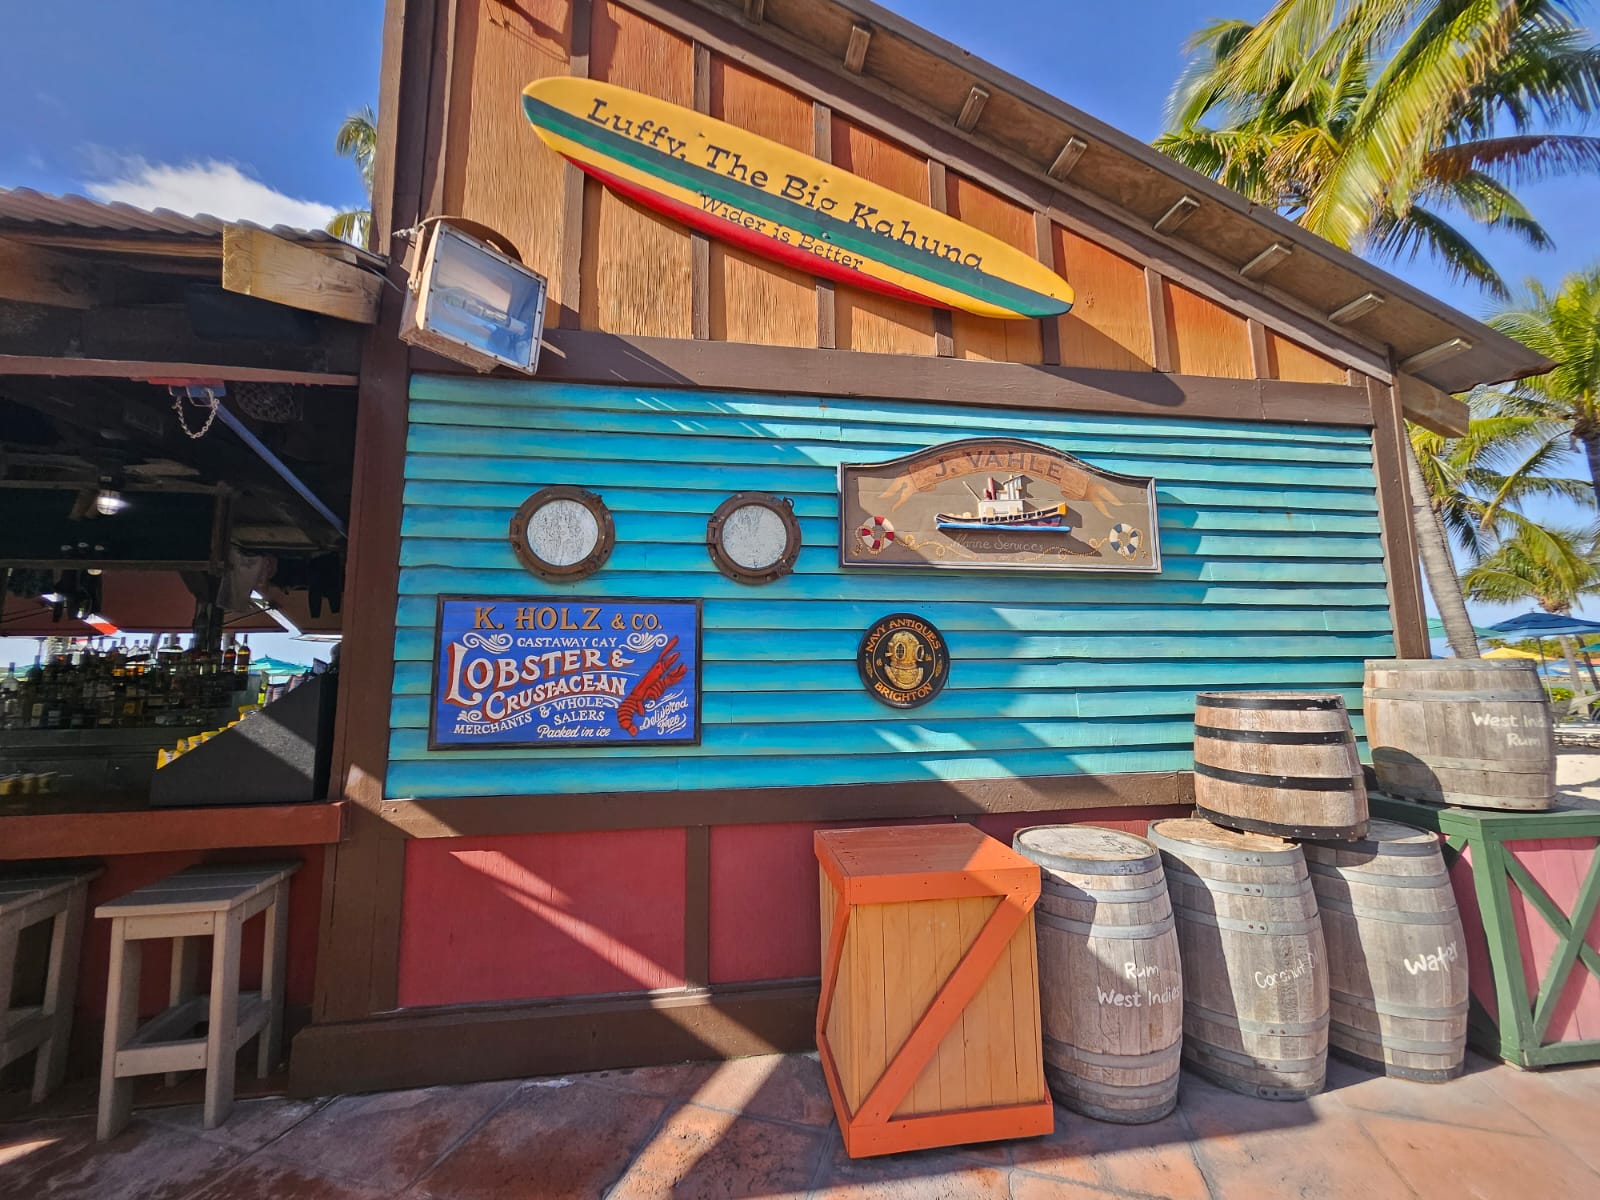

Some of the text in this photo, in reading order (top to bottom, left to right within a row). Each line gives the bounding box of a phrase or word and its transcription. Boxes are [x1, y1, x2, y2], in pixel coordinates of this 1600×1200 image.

[704, 144, 768, 188] The
[780, 174, 838, 220] Big
[849, 202, 983, 271] Kahuna
[700, 193, 863, 271] Wider is Better
[936, 450, 1064, 480] J. VAHLE
[473, 606, 663, 630] K. HOLZ & CO.
[516, 637, 617, 648] CASTAWAY CAY
[865, 619, 941, 652] NAVY ANTIQUES
[444, 642, 635, 707] LOBSTER &
[482, 673, 628, 723] CRUSTACEAN
[874, 682, 933, 702] BRIGHTON
[453, 712, 533, 735] MERCHANTS
[540, 705, 551, 718] &
[553, 710, 605, 726] SALERS
[1471, 711, 1518, 728] West
[537, 724, 611, 738] Packed in ice
[1506, 733, 1539, 747] Rum
[1124, 962, 1159, 979] Rum
[1097, 986, 1142, 1007] West
